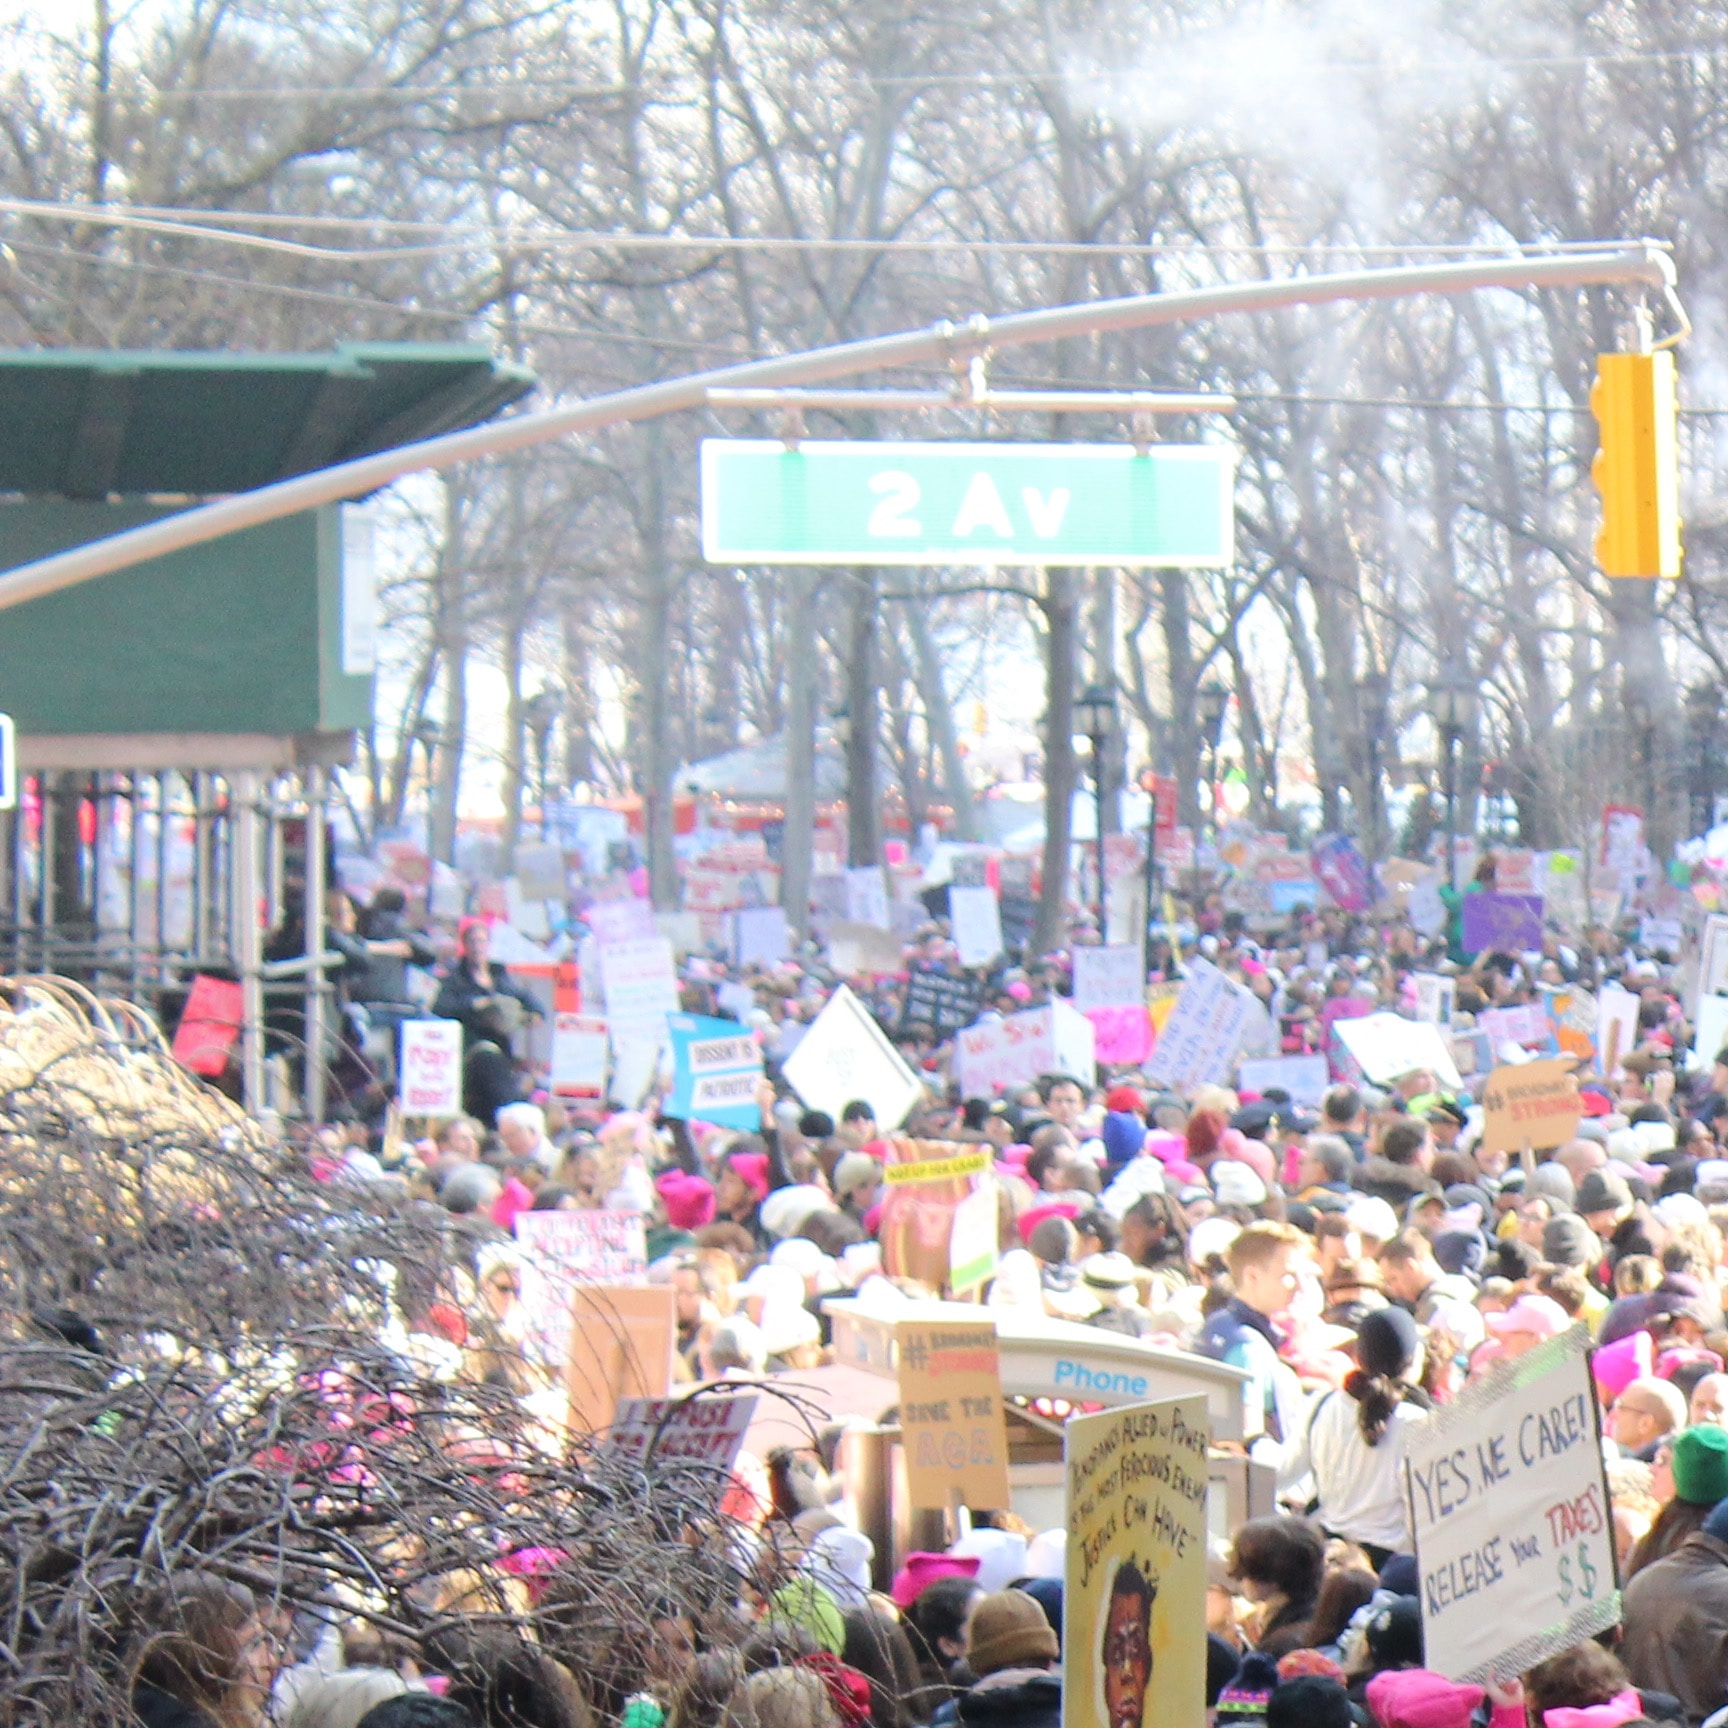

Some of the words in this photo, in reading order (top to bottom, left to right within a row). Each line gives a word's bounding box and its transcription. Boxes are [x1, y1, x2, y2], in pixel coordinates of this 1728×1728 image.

[867, 470, 921, 537] 2
[951, 471, 1070, 537] Av
[1054, 1359, 1149, 1396] Phone
[1518, 1394, 1588, 1467] CARE!
[1123, 1494, 1149, 1530] CAN
[1425, 1536, 1502, 1618] RELEASE
[1509, 1536, 1543, 1566] YOUR
[1544, 1489, 1605, 1551] TAXES
